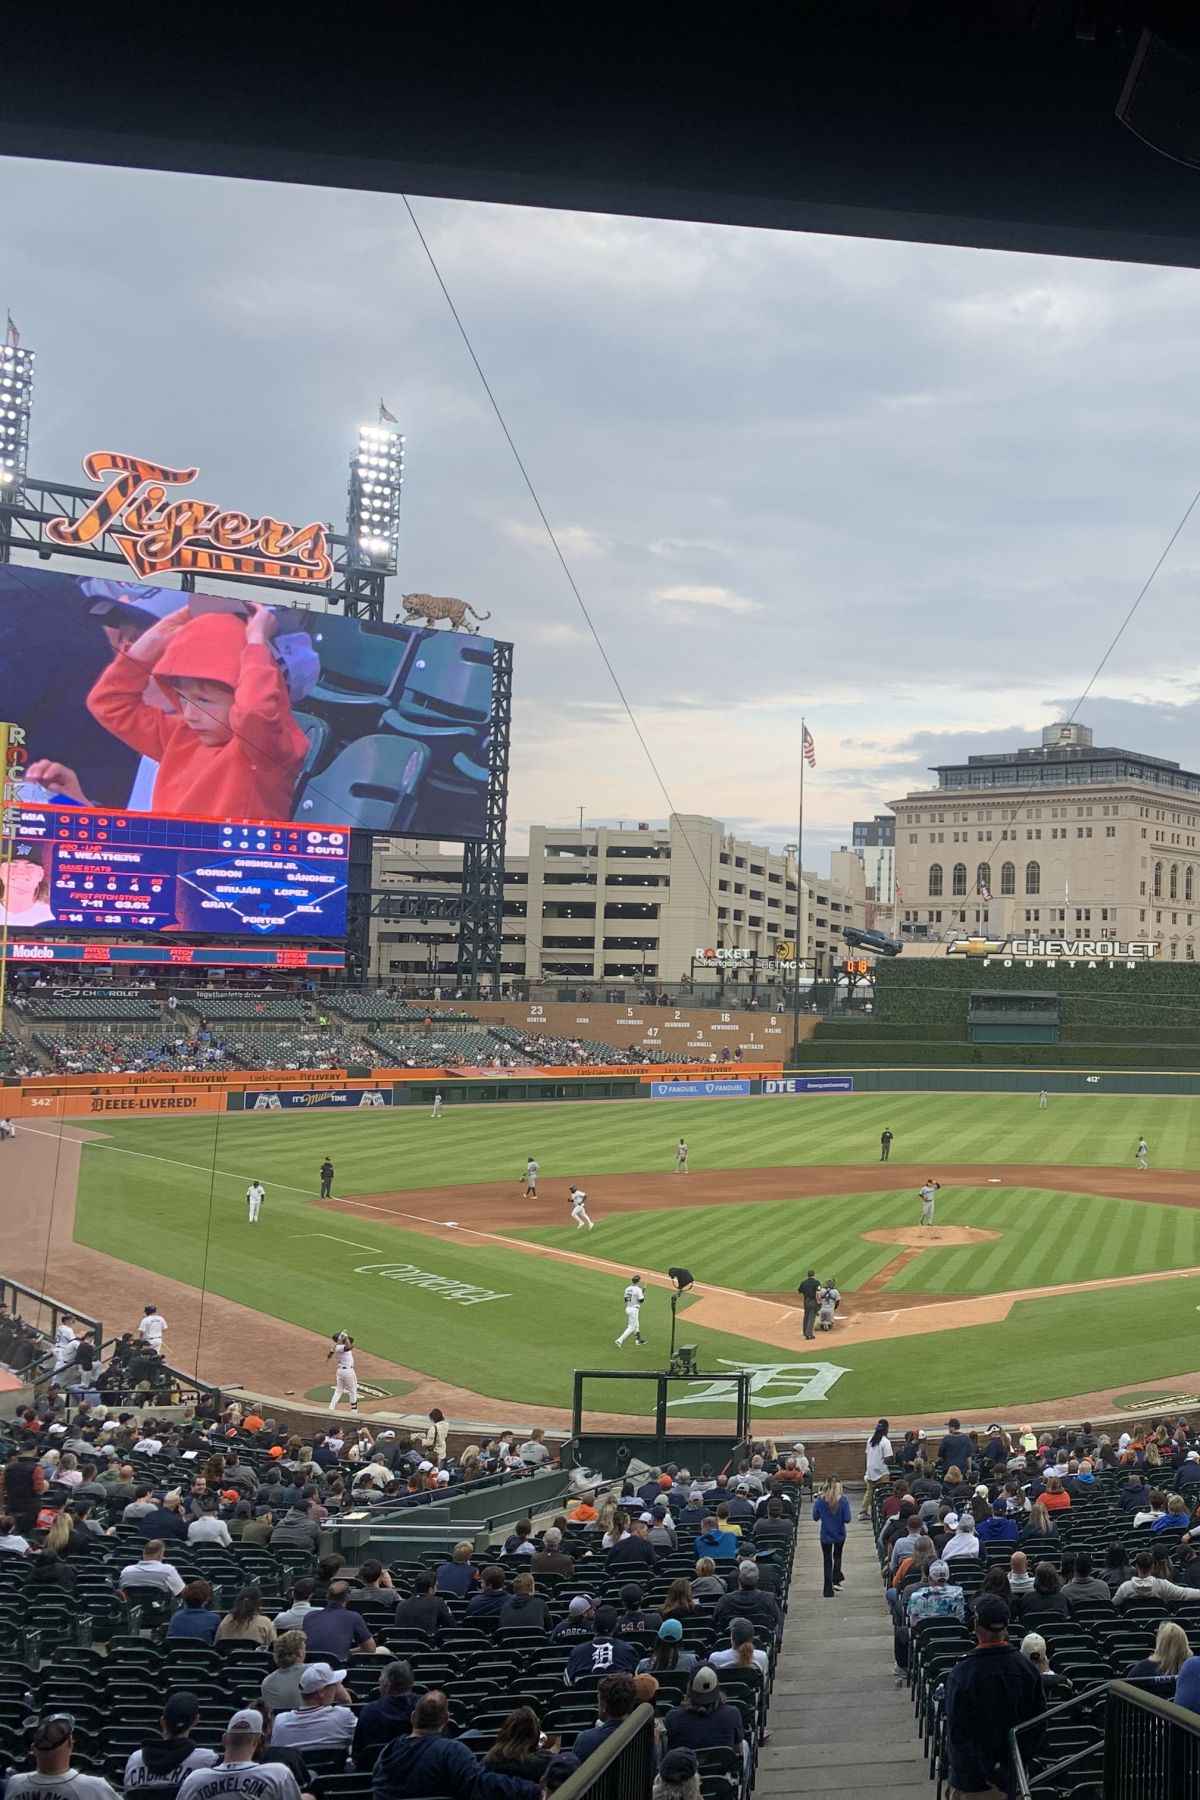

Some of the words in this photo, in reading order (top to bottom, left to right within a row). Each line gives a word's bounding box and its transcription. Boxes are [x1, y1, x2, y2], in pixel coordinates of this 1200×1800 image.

[46, 451, 334, 582] Tigers
[21, 813, 45, 822] MIA
[59, 815, 70, 823] 0
[98, 818, 108, 826] 0
[116, 819, 127, 827] 0
[223, 826, 232, 835] 0
[242, 828, 249, 836] 1
[256, 829, 266, 837] 0
[307, 831, 344, 845] 0-0
[19, 827, 46, 836] DET
[58, 829, 70, 837] 0
[78, 830, 89, 838] 0
[97, 831, 107, 839] 0
[222, 840, 232, 848] 0
[256, 842, 266, 850] 0
[272, 843, 282, 851] 0
[288, 844, 298, 852] 4
[315, 847, 344, 855] OUTS
[59, 850, 71, 858] R.
[74, 851, 141, 863] WEATHERS
[234, 859, 283, 870] CHISHOLM
[284, 862, 298, 870] JR.
[196, 868, 242, 878] GORDON
[287, 873, 335, 883] SÁNCHEZ
[56, 880, 76, 888] 3.2
[84, 881, 94, 889] 0
[106, 882, 117, 890] 0
[151, 885, 162, 893] 0
[216, 885, 261, 895] BRUJÁN
[274, 888, 309, 897] LOPEZ
[81, 900, 104, 908] 7-11
[115, 900, 150, 910] 63.6%
[202, 901, 234, 909] GRAY
[297, 905, 323, 913] BELL
[69, 914, 83, 922] 14
[104, 915, 122, 924] 33
[139, 917, 156, 925] 47
[242, 916, 285, 925] FORTES
[13, 945, 55, 959] Modelo
[85, 946, 110, 954] PITCH
[695, 948, 750, 959] ROCKET
[1011, 939, 1160, 958] CHEVROLET
[703, 960, 743, 969] Mortgage
[983, 960, 1136, 969] FOUNTAIN
[531, 1005, 543, 1015] 23
[627, 1008, 633, 1017] 5
[674, 1010, 681, 1020] 2
[721, 1013, 731, 1022] 16
[770, 1016, 777, 1026] 6
[647, 1027, 659, 1037] 47
[696, 1031, 703, 1040] 3
[715, 1084, 744, 1092] FANDUEL
[766, 1080, 796, 1093] DTE
[303, 1092, 336, 1106] Miller
[592, 1642, 614, 1673] D
